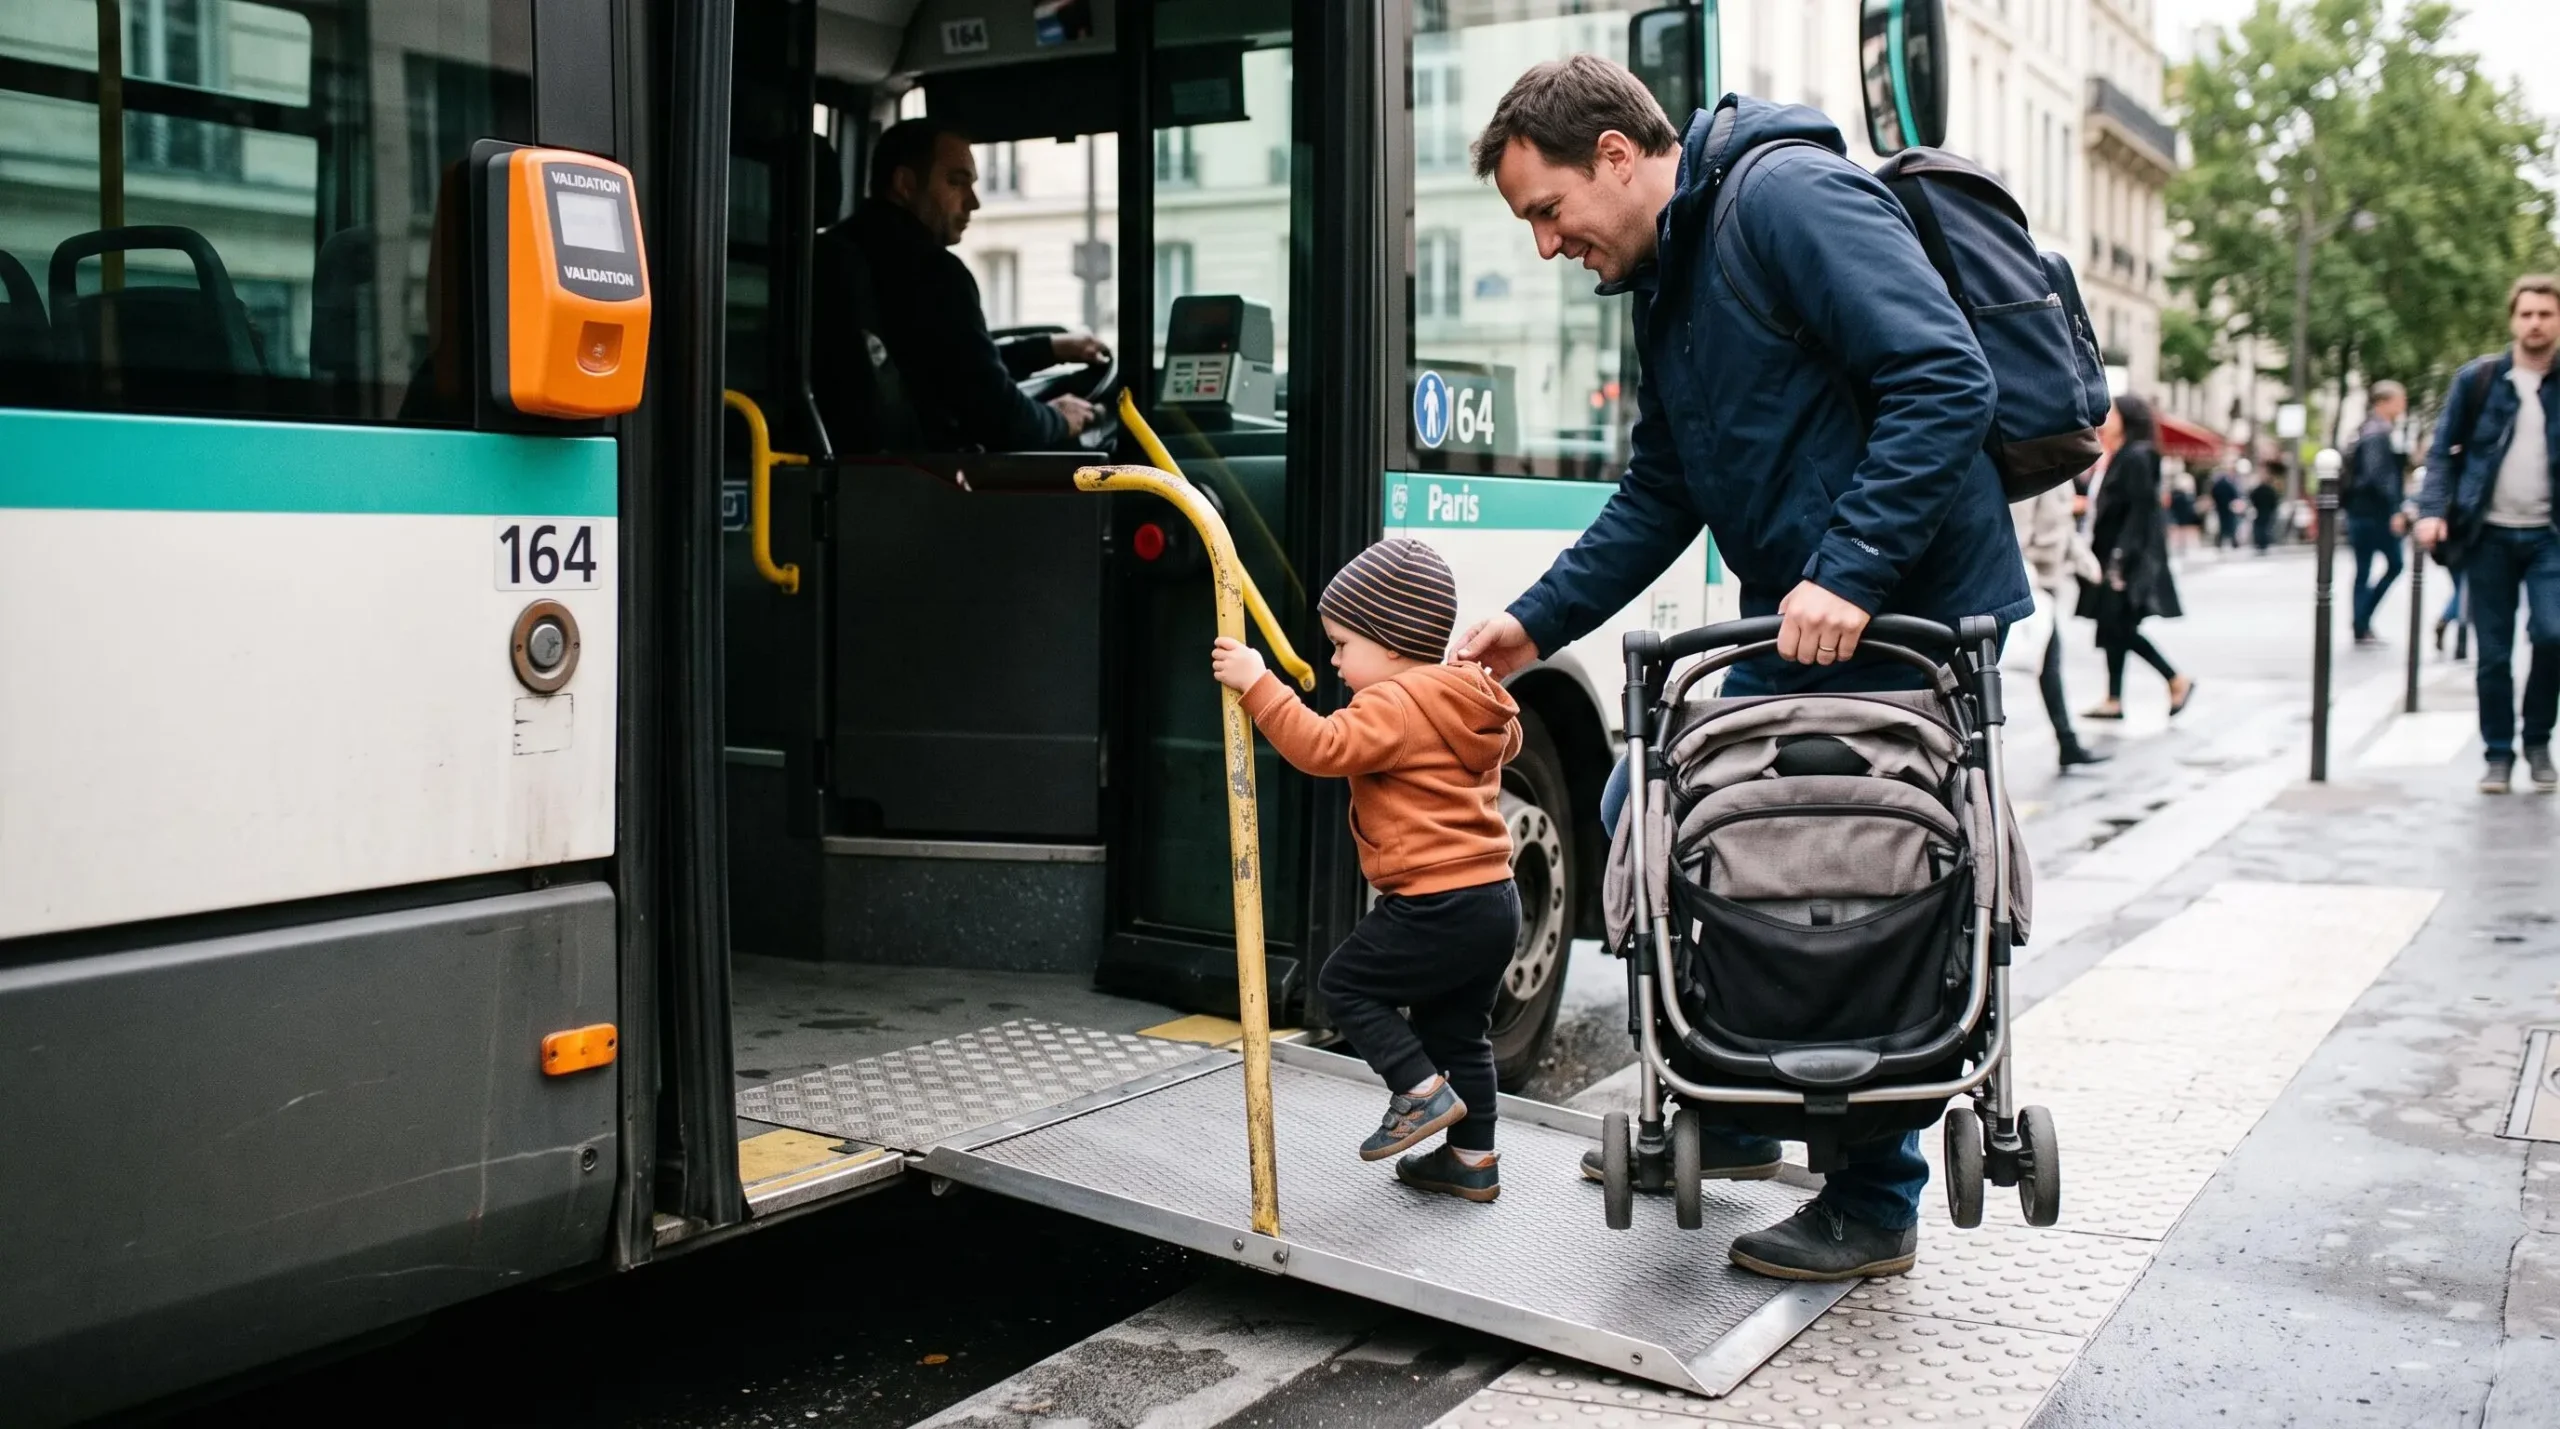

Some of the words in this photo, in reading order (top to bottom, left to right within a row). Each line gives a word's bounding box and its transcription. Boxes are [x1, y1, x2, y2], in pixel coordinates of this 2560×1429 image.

[950, 25, 983, 48] 164
[551, 171, 621, 194] VALIDATION
[564, 265, 634, 286] VALIDATION
[1446, 386, 1494, 445] 164
[1428, 484, 1479, 523] Paris
[499, 524, 597, 584] 164
